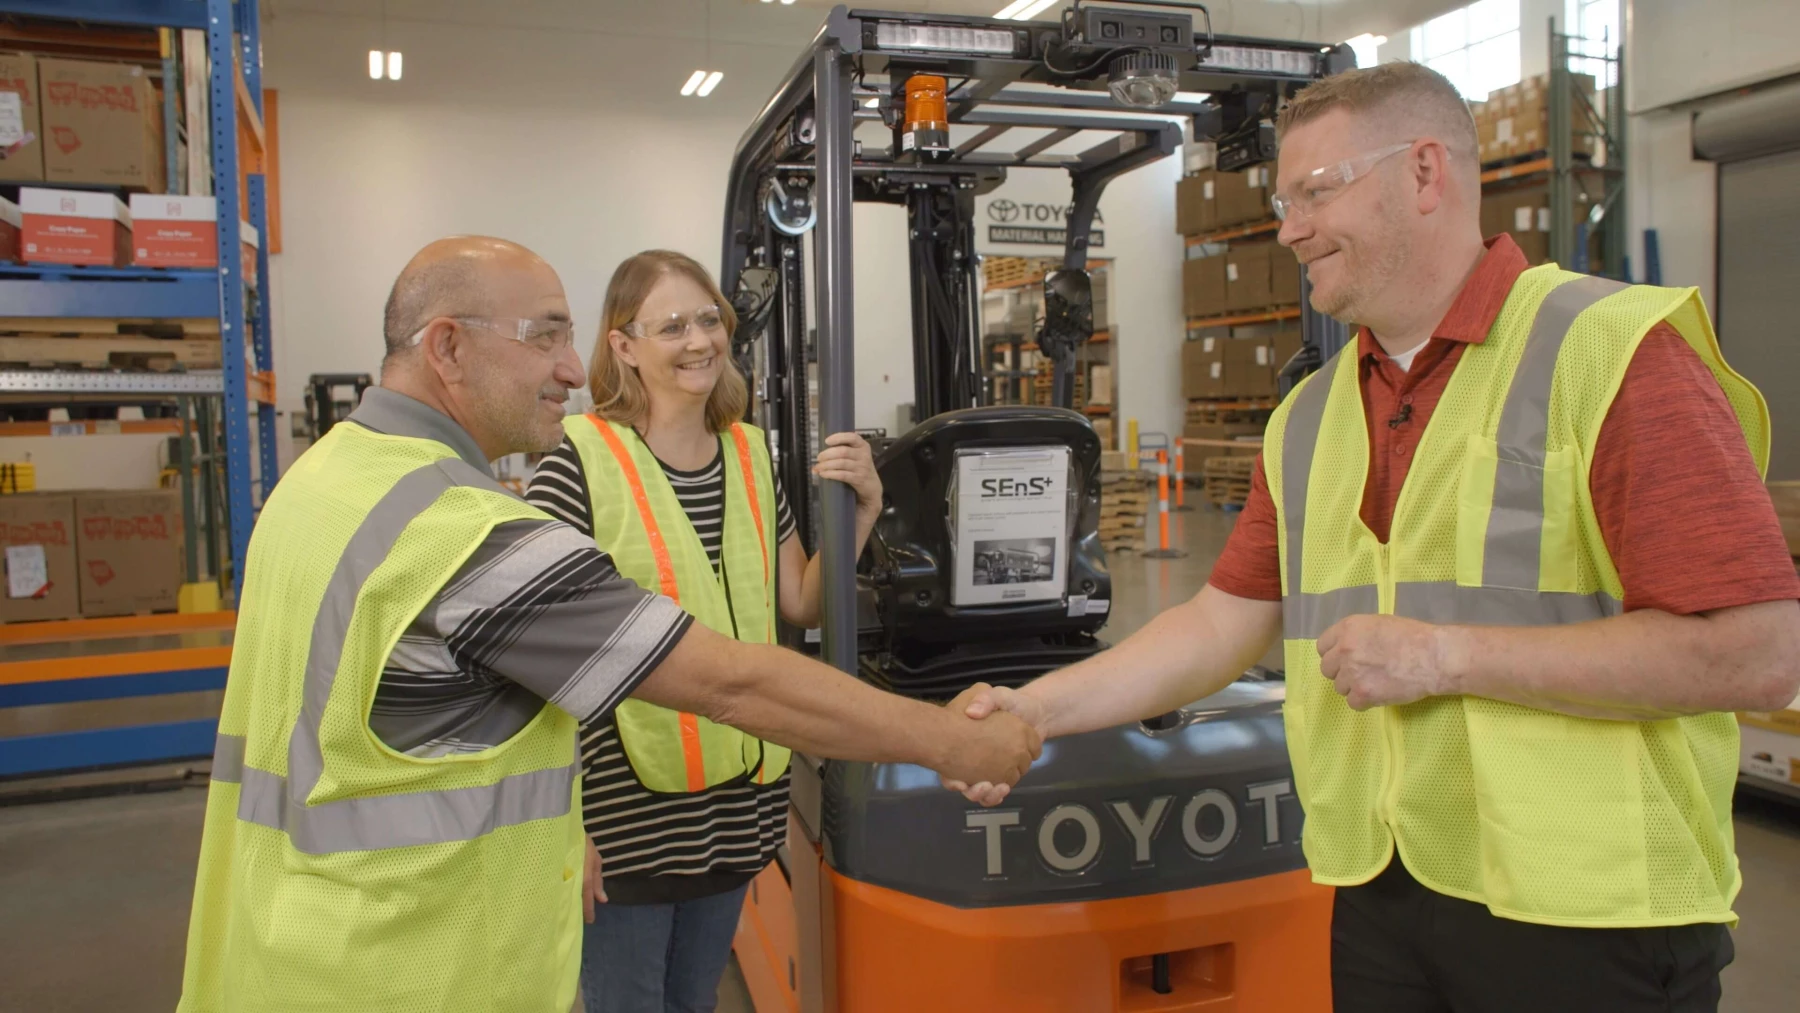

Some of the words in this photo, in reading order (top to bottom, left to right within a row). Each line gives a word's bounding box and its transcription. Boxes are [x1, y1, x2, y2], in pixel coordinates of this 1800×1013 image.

[1021, 203, 1104, 223] TOYA
[991, 228, 1046, 243] MATERIAL
[1047, 231, 1103, 246] HANG
[963, 778, 1298, 877] TOYOT
